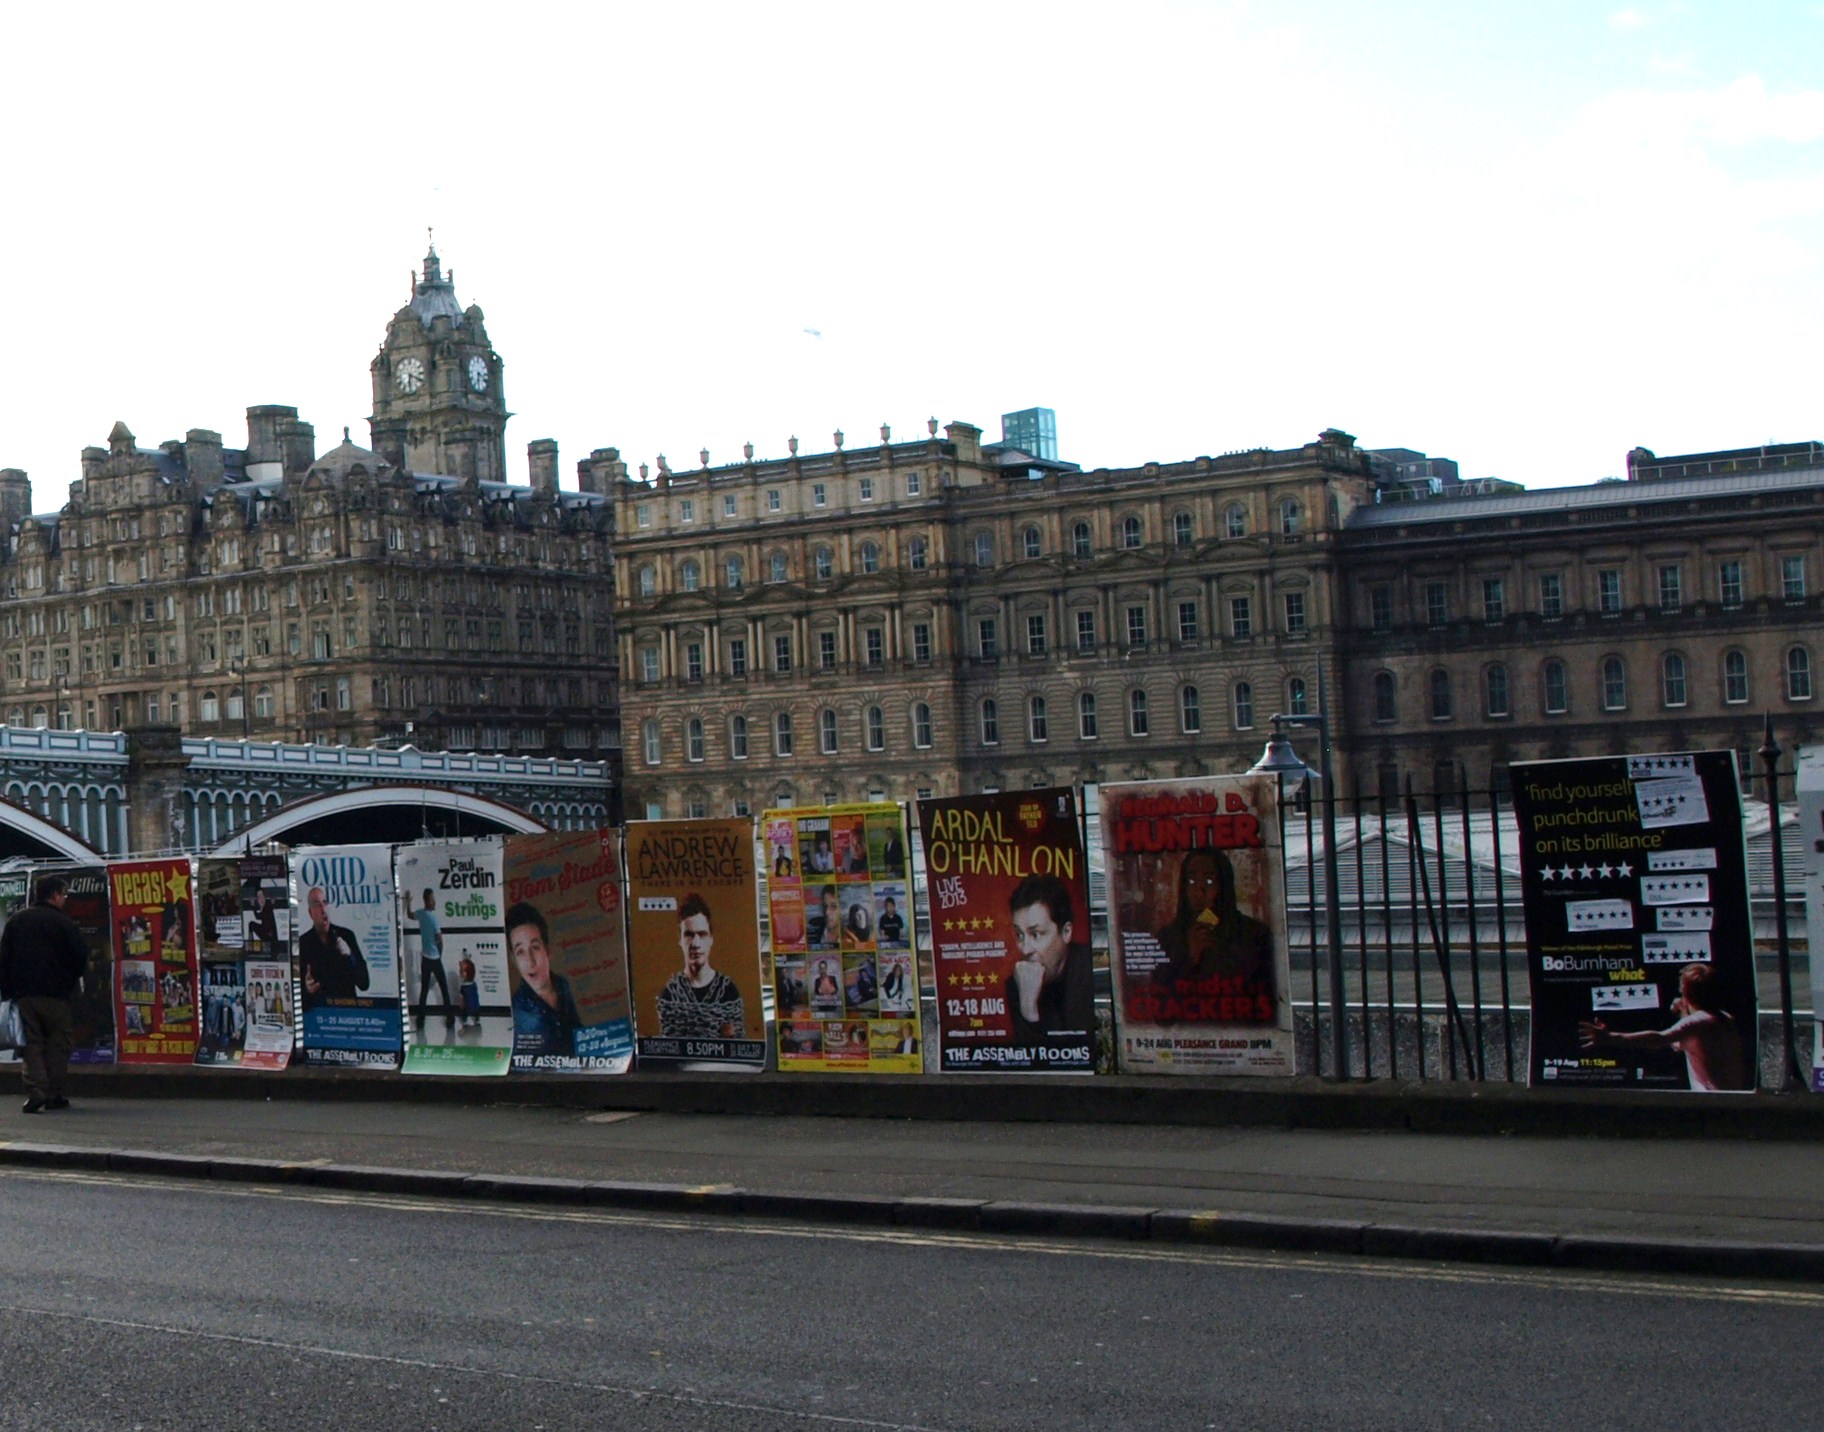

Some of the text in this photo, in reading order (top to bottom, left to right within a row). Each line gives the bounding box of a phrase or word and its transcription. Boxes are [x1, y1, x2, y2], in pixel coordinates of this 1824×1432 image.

[1564, 778, 1634, 804] yourself
[930, 808, 1014, 843] ARDAL
[1533, 804, 1639, 832] punchdrunk
[1114, 814, 1262, 853] HUNTER
[1536, 829, 1666, 853] on its brilliance'
[639, 835, 738, 860] ANDREW
[449, 857, 475, 872] Paul
[639, 858, 743, 880] LAWRENCE
[930, 841, 1074, 880] O'HANLON
[302, 856, 365, 887] OMID
[438, 866, 495, 890] Zerdin
[326, 884, 381, 908] DJALILI
[936, 875, 963, 896] LIVE
[470, 893, 484, 904] No
[939, 889, 968, 909] 2013
[444, 900, 497, 920] Strings
[1608, 968, 1646, 981] what
[946, 998, 1005, 1016] 12-18 AUG
[306, 1049, 396, 1064] THE ASSEMBLY ROOMS
[686, 1042, 724, 1056] 8.50PM
[945, 1046, 1090, 1062] THE ASSEMBLY ROOMS
[512, 1055, 534, 1067] THE
[535, 1054, 587, 1069] ASSEMBLY
[1563, 1059, 1579, 1068] Aug
